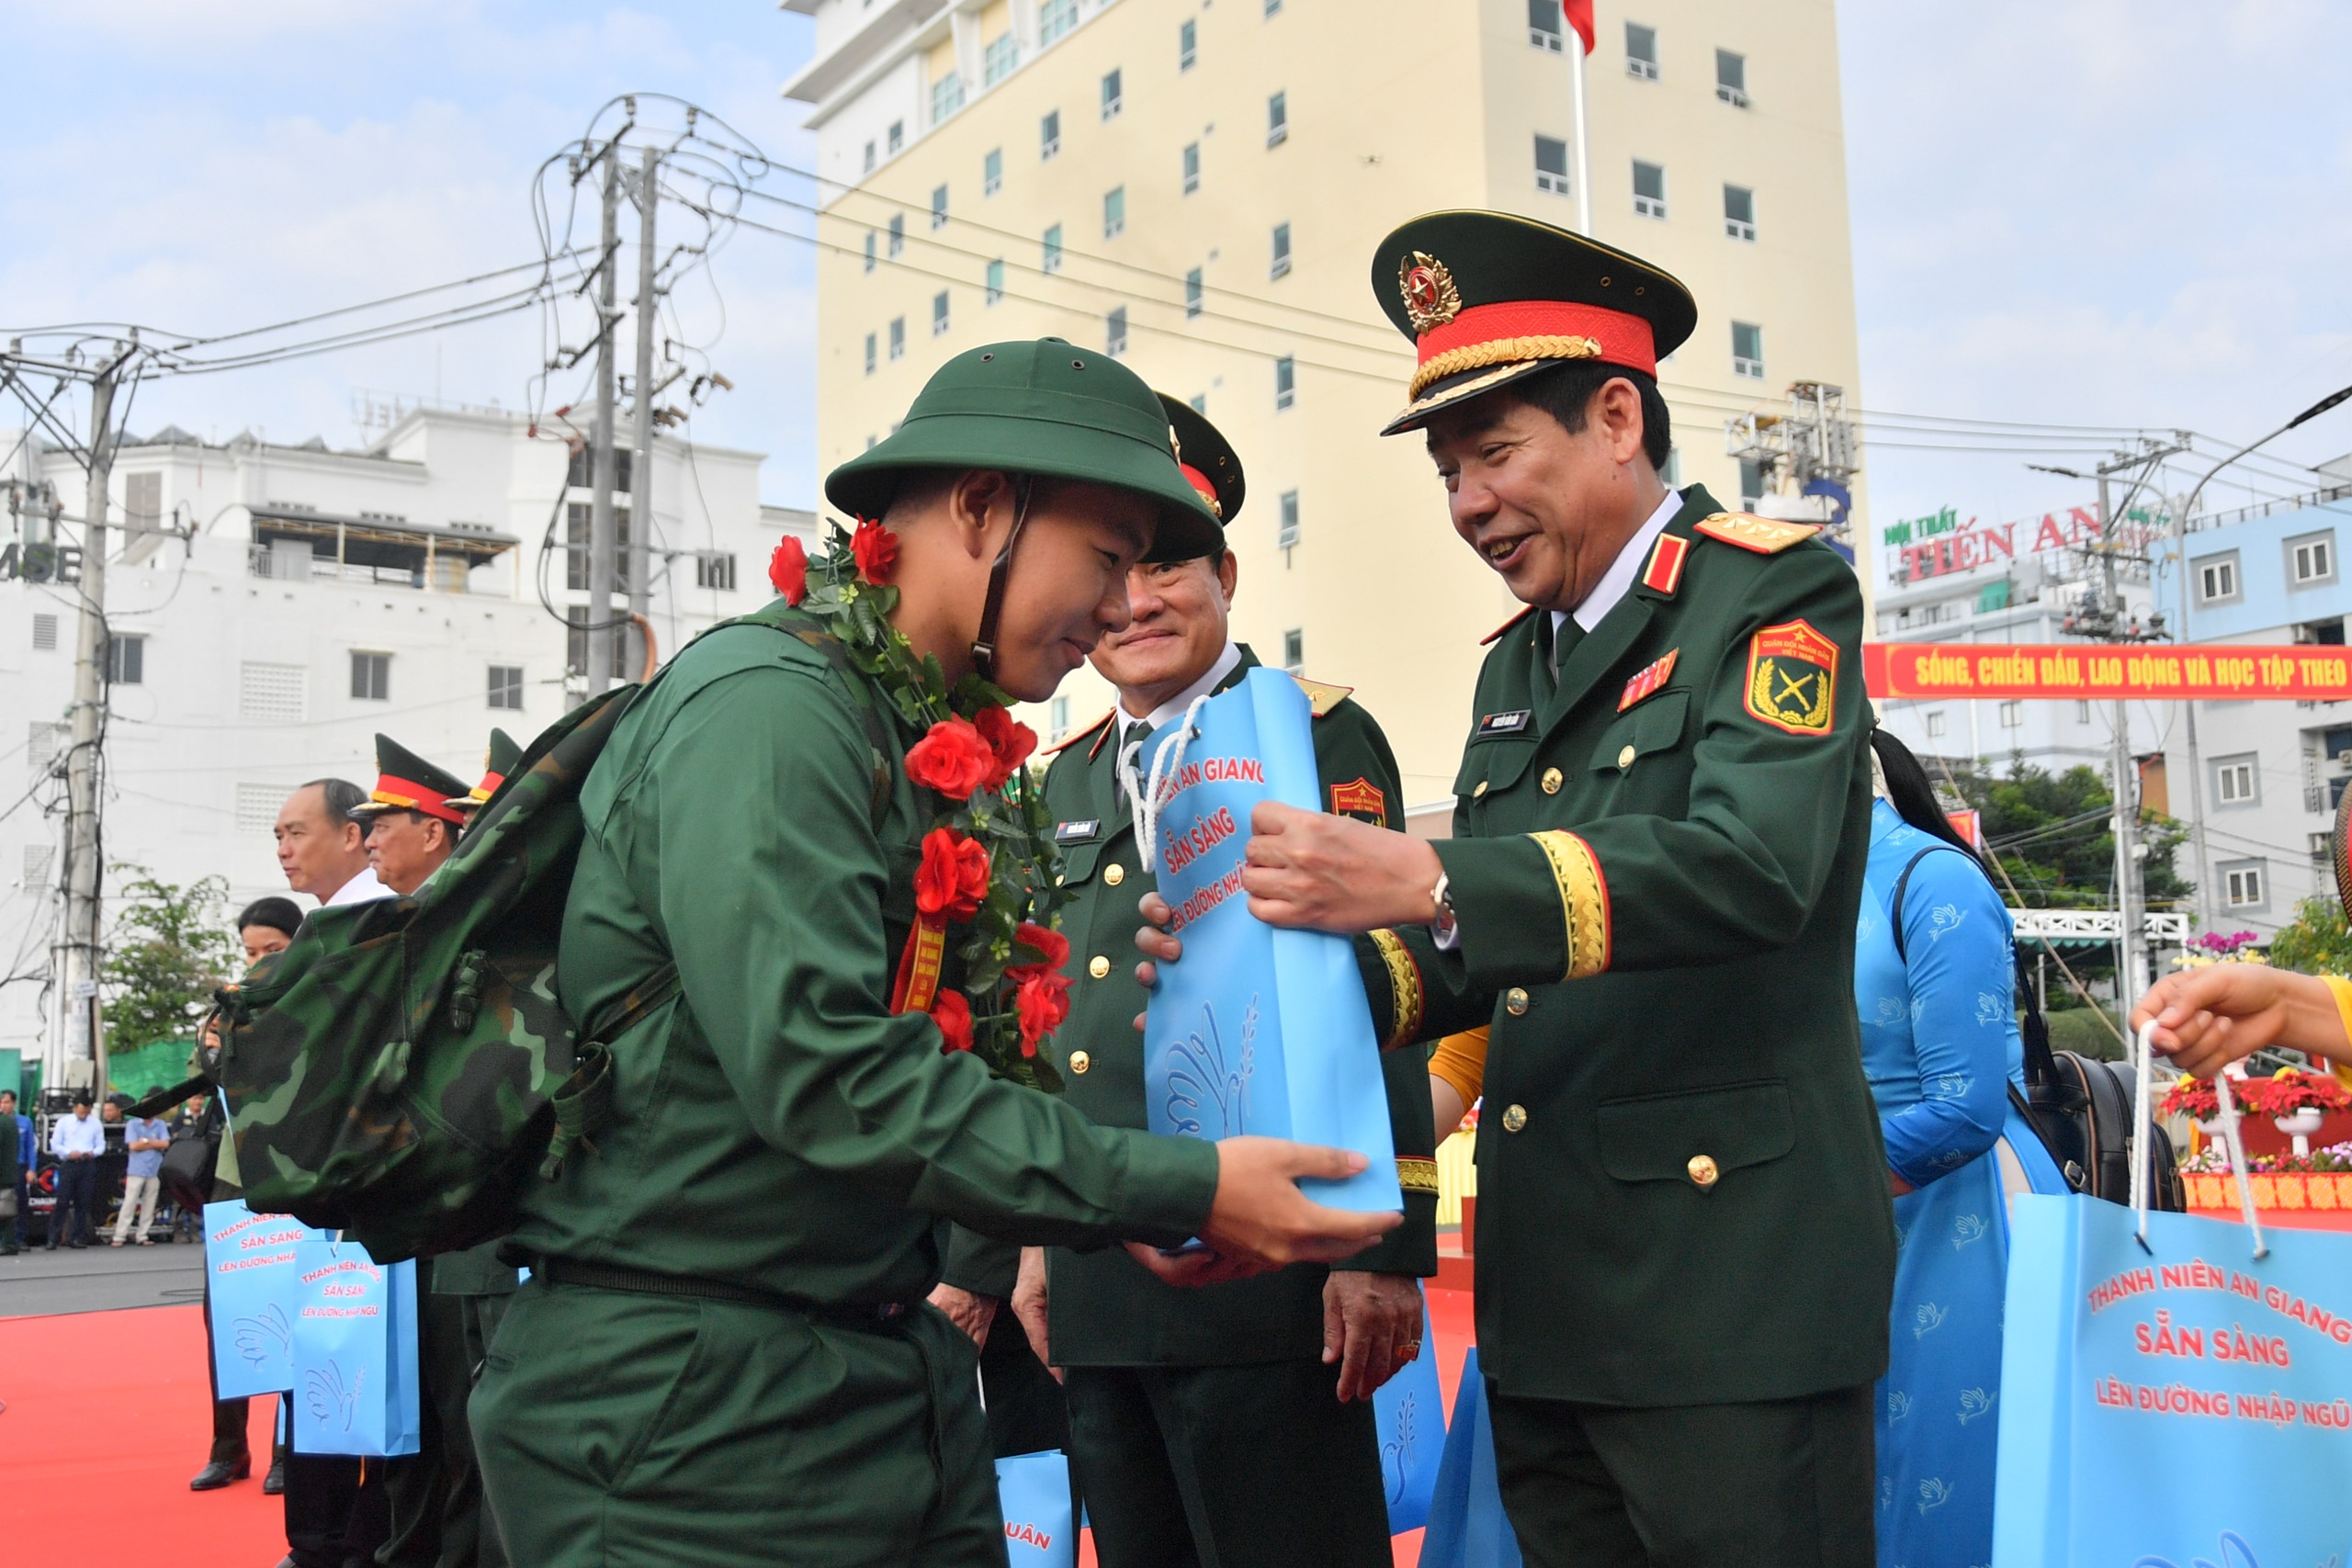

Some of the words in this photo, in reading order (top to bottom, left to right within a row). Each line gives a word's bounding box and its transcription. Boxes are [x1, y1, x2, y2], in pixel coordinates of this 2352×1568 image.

[1916, 503, 1957, 537] THẤT
[1900, 516, 2017, 583] TIẾN
[2031, 502, 2101, 553] AN
[1915, 647, 1973, 687] SỐNG,
[1978, 647, 2036, 686] CHIẾN
[2040, 647, 2085, 687] ĐẤU,
[2088, 657, 2124, 686] LAO
[2127, 652, 2181, 691] ĐỘNG
[2184, 653, 2211, 686] VÀ
[2214, 658, 2256, 691] HỌC
[2258, 653, 2295, 691] TẬP
[2299, 658, 2347, 687] THEO
[1180, 761, 1202, 789] AN
[1190, 807, 1236, 854] SÀNG
[1183, 882, 1224, 921] ĐƯỜNG
[213, 1219, 250, 1241] THANH
[301, 1265, 336, 1283] THANH
[2088, 1268, 2154, 1313] THANH
[2160, 1258, 2224, 1289] NIÊN
[2230, 1271, 2259, 1301] AN
[2265, 1286, 2352, 1343] GIANG
[2136, 1309, 2203, 1358] SẴN
[2212, 1323, 2289, 1367] SÀNG
[2096, 1375, 2133, 1407] LÊN
[2138, 1382, 2230, 1416] ĐƯỜNG
[2235, 1391, 2297, 1426] NHẬP
[2301, 1399, 2350, 1427] NGŨ
